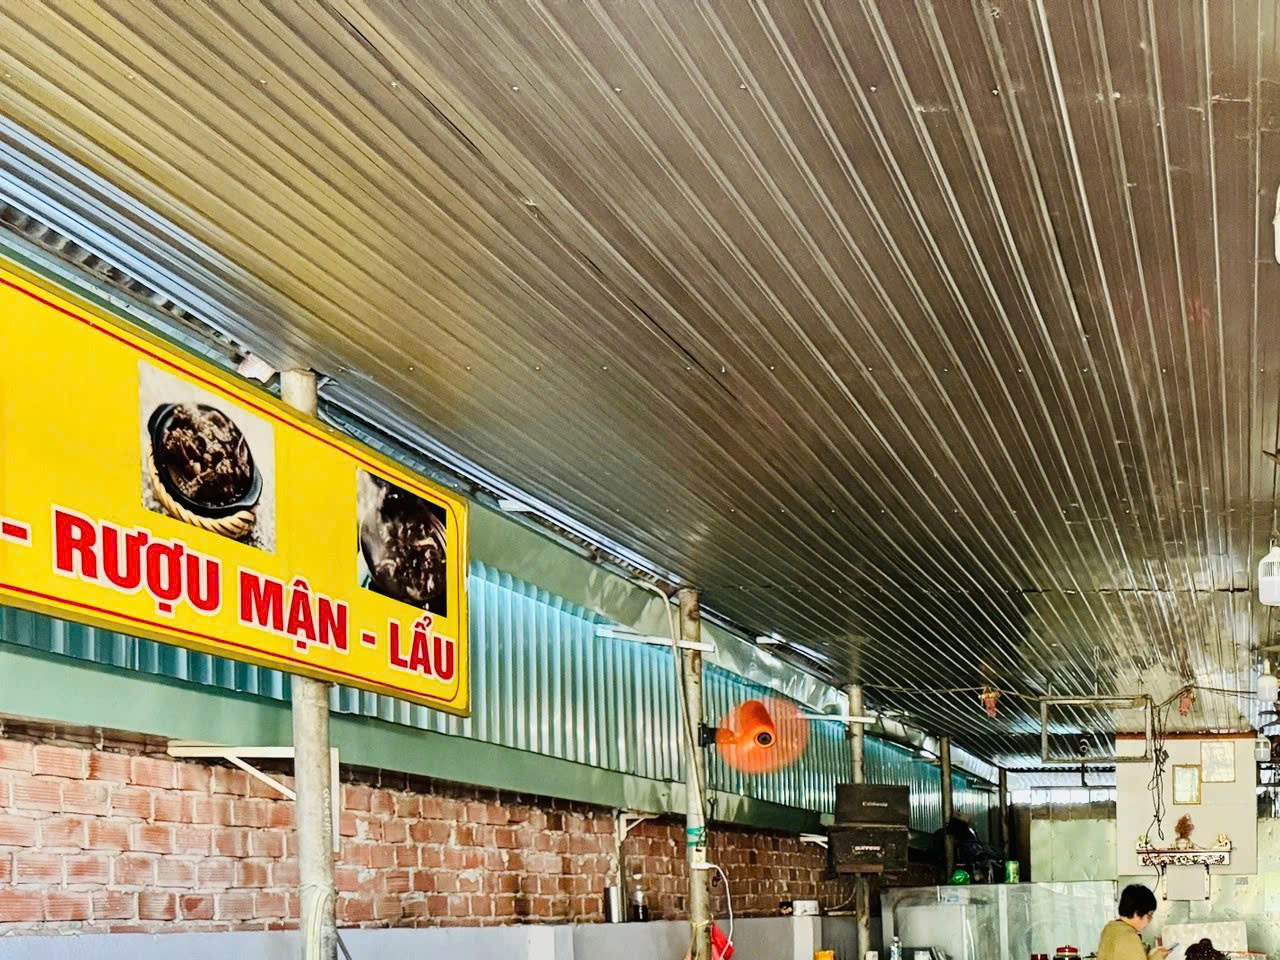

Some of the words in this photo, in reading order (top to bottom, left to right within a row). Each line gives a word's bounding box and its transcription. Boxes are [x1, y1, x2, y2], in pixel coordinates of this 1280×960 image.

[54, 509, 219, 613] RƯỢU
[240, 571, 348, 648] MẬN
[389, 616, 454, 680] LẨU
